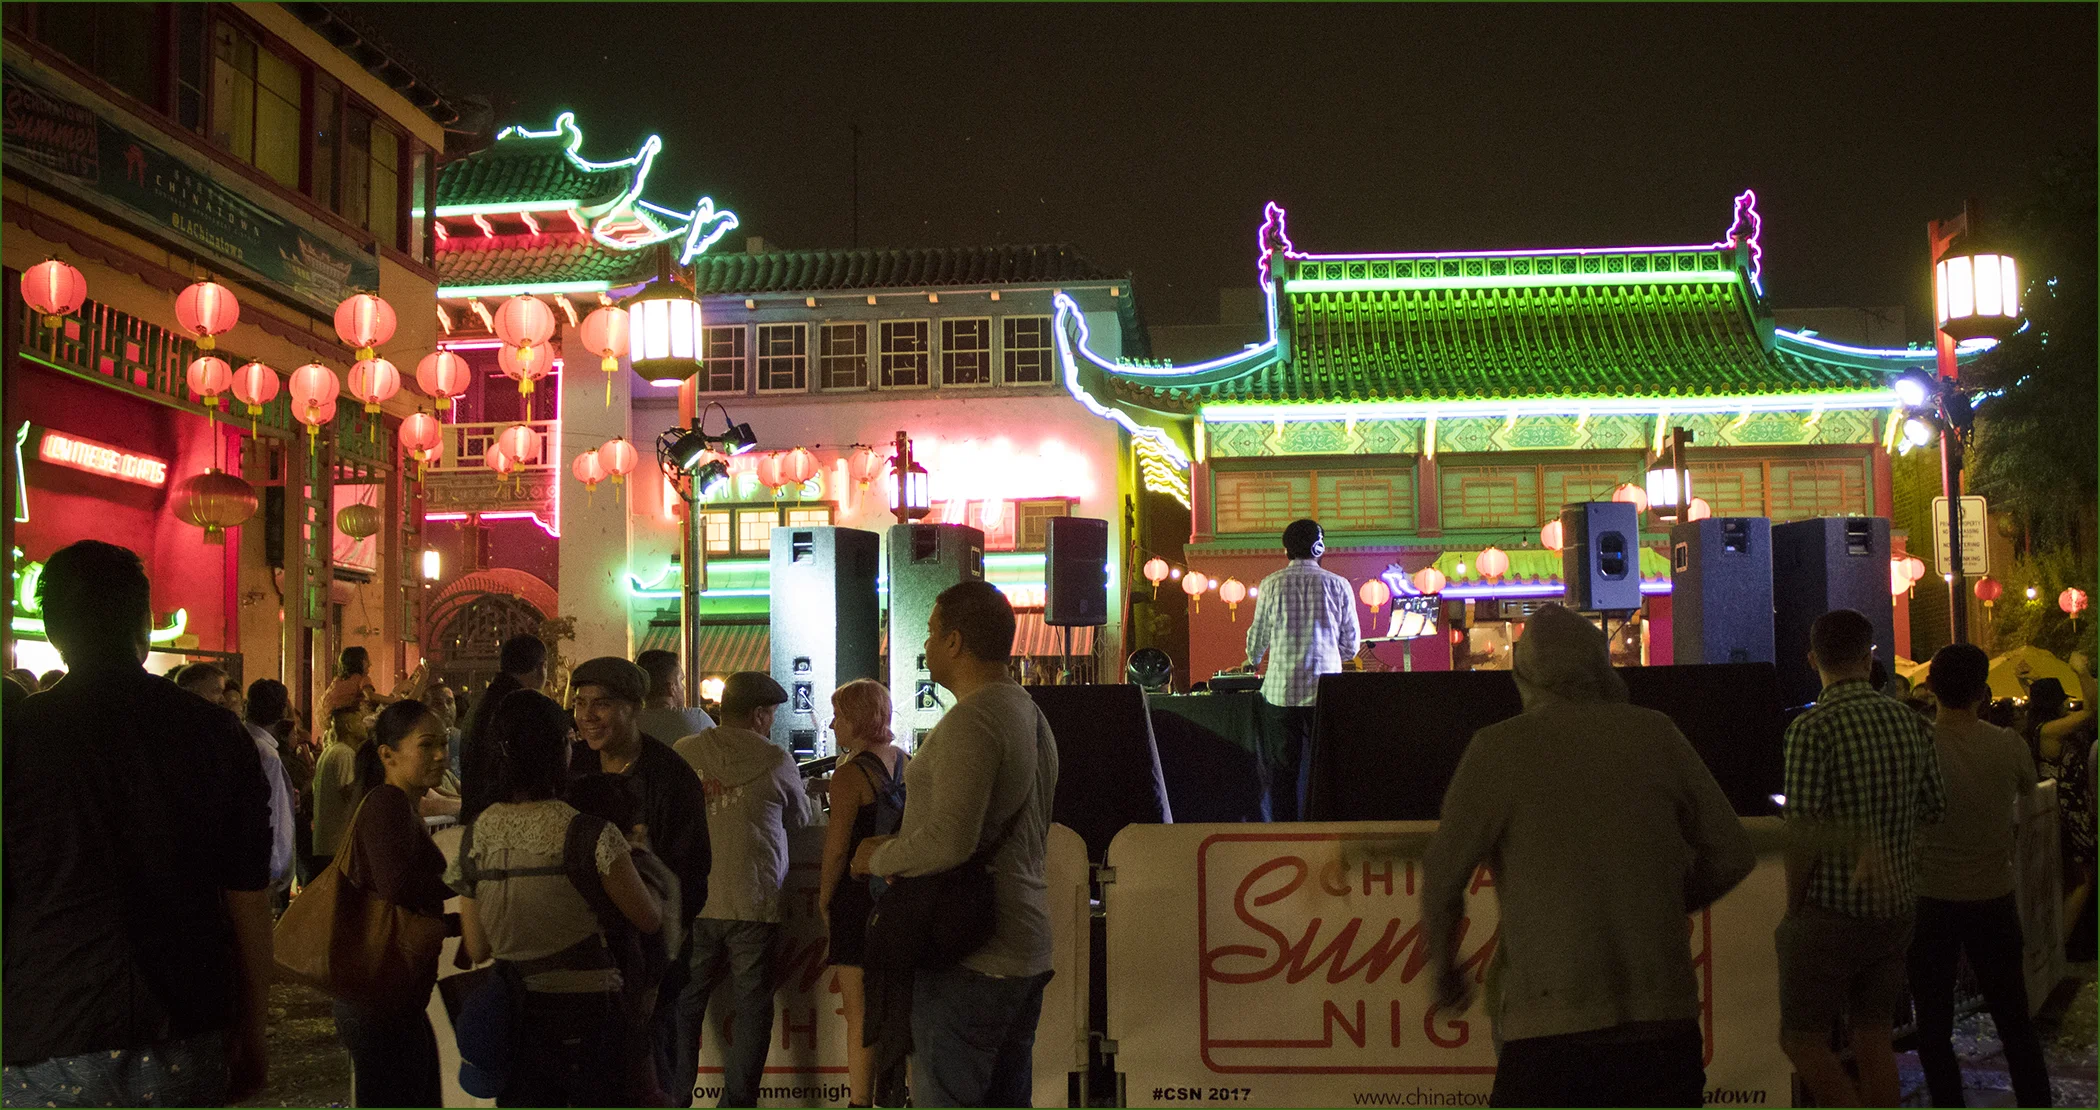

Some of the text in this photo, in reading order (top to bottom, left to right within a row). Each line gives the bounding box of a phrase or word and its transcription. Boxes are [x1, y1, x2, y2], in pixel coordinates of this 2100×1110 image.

[155, 174, 260, 237] CHINATOWN
[171, 211, 244, 260] @LAChinatown
[1322, 999, 1471, 1050] NIG
[1151, 1087, 1252, 1101] #CSN 2017
[1352, 1087, 1493, 1106] www.chinatow
[1702, 1087, 1767, 1105] atown
